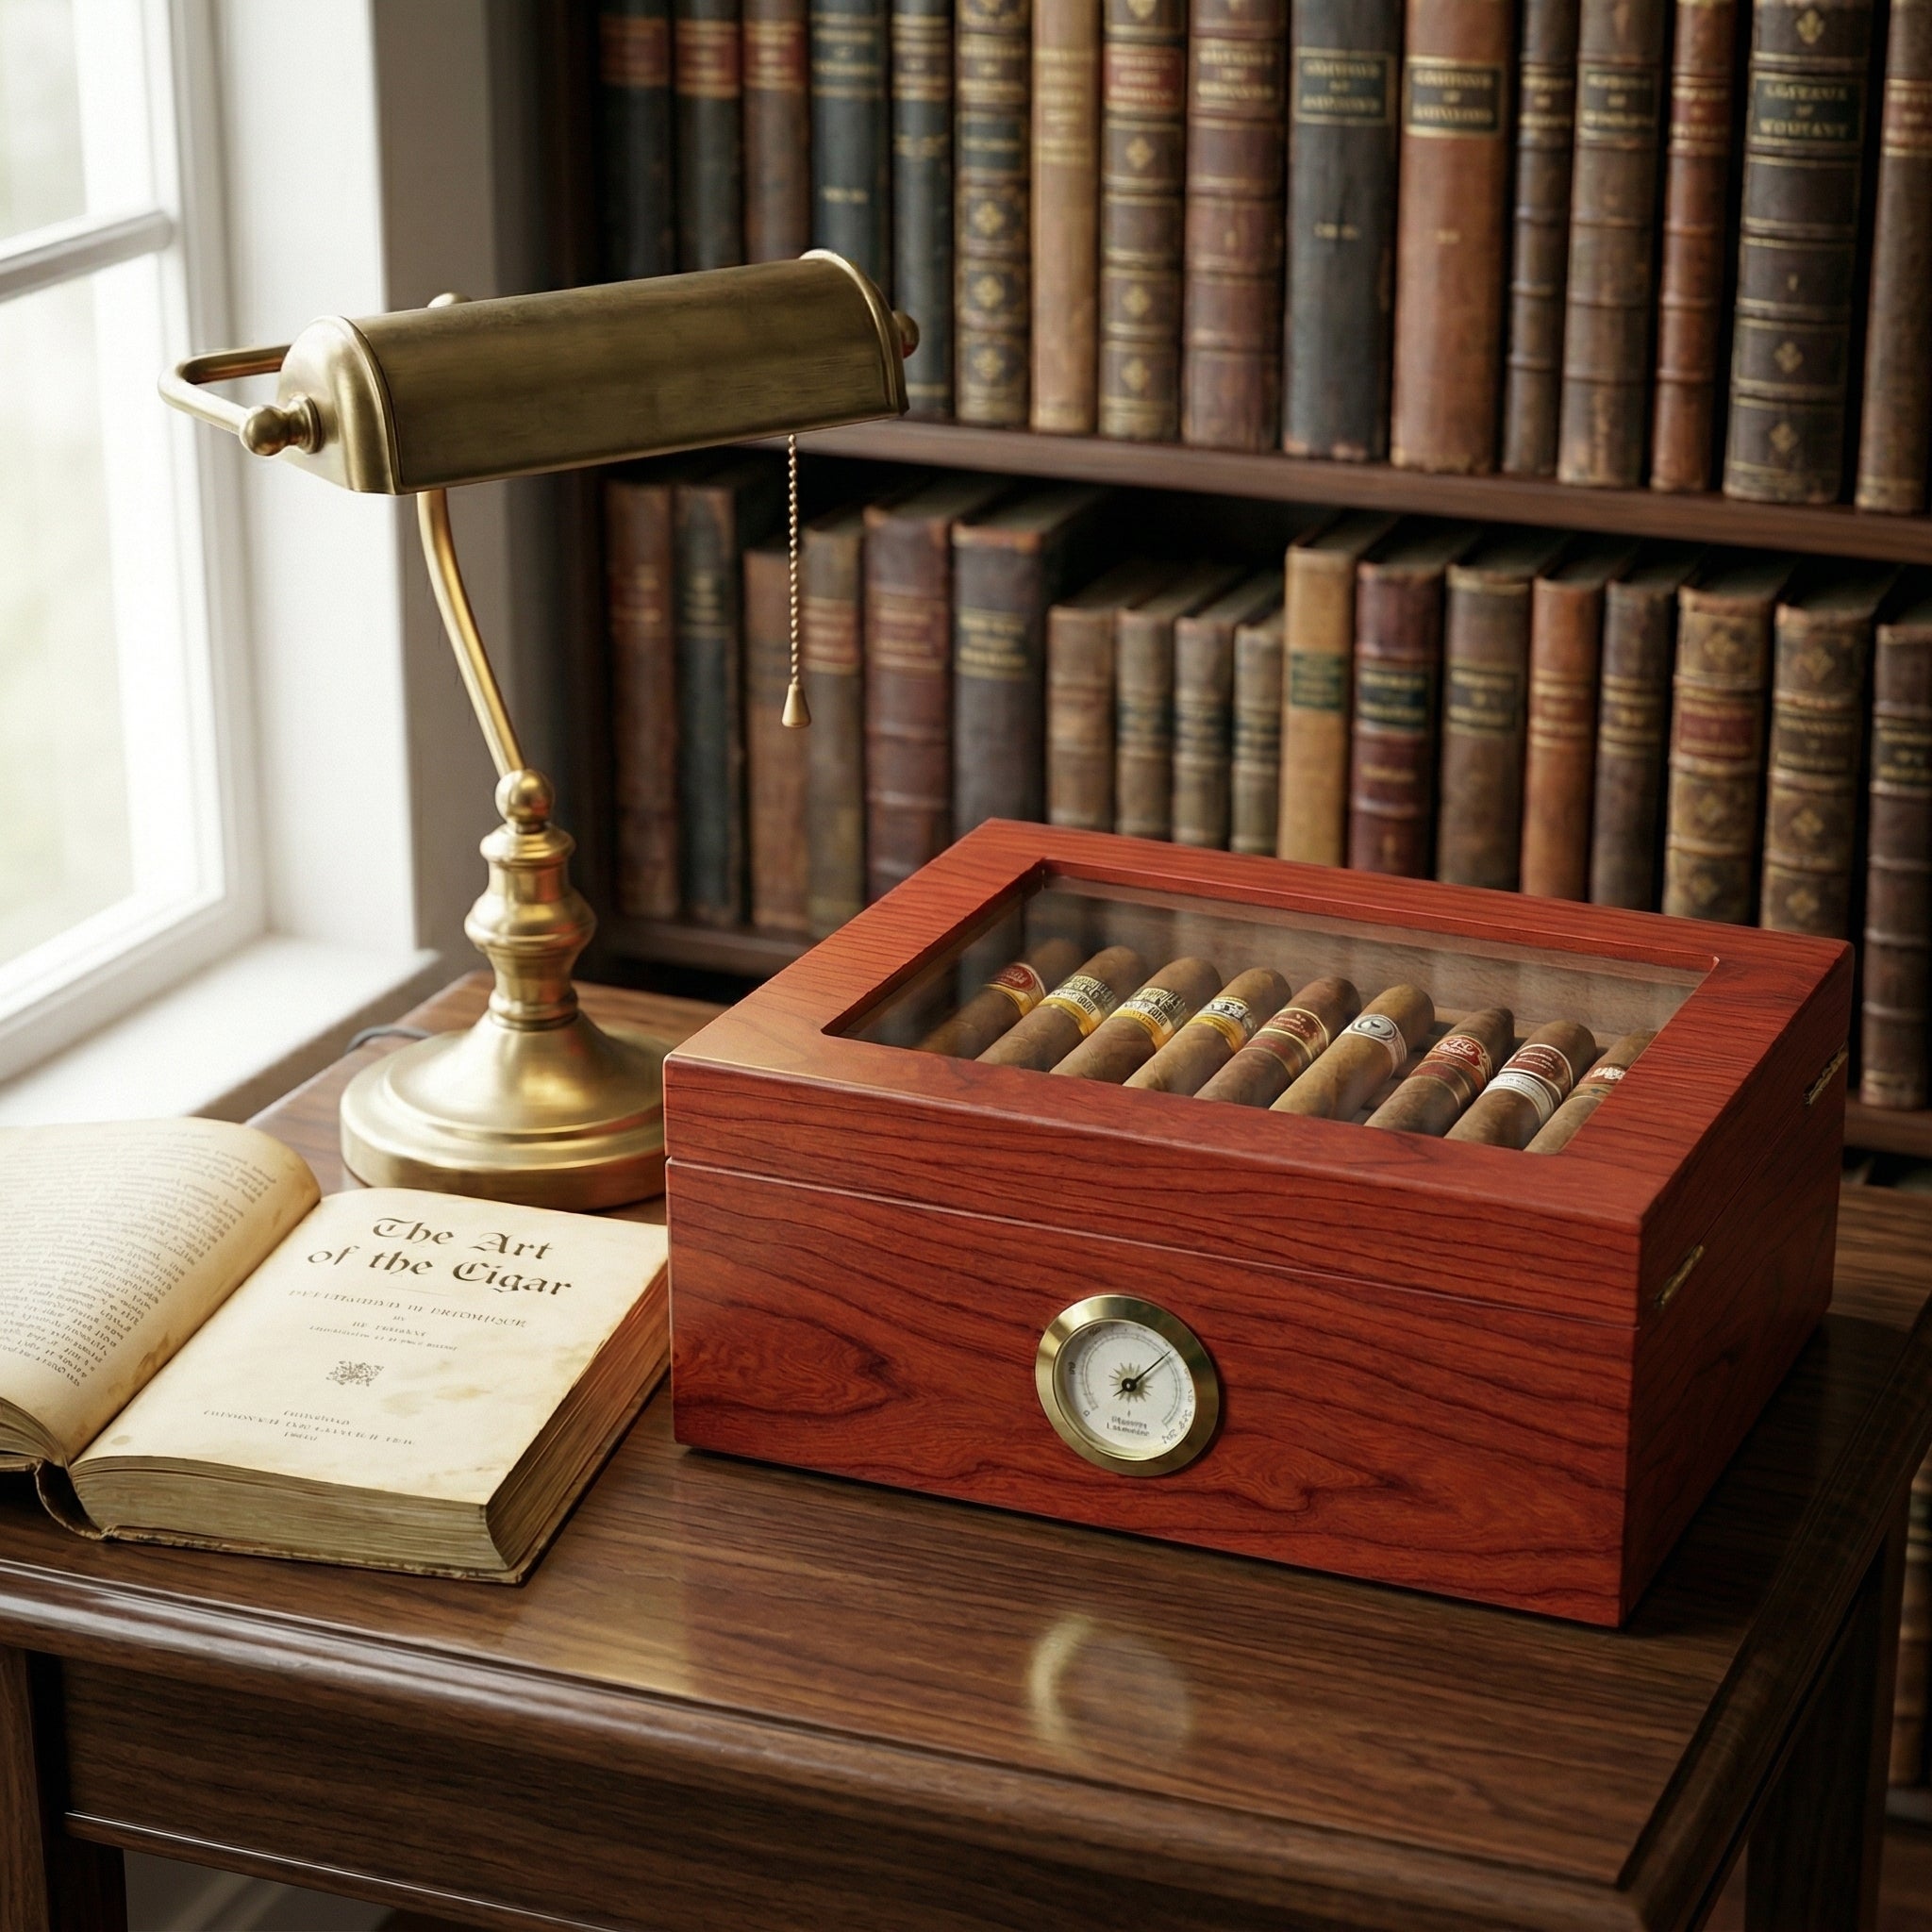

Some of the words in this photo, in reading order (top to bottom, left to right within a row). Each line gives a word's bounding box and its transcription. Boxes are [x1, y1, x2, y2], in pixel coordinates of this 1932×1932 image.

[373, 1218, 454, 1246] The
[470, 1232, 553, 1260] Art
[308, 1245, 360, 1265] of
[368, 1251, 433, 1276] the
[452, 1261, 573, 1296] Cigar
